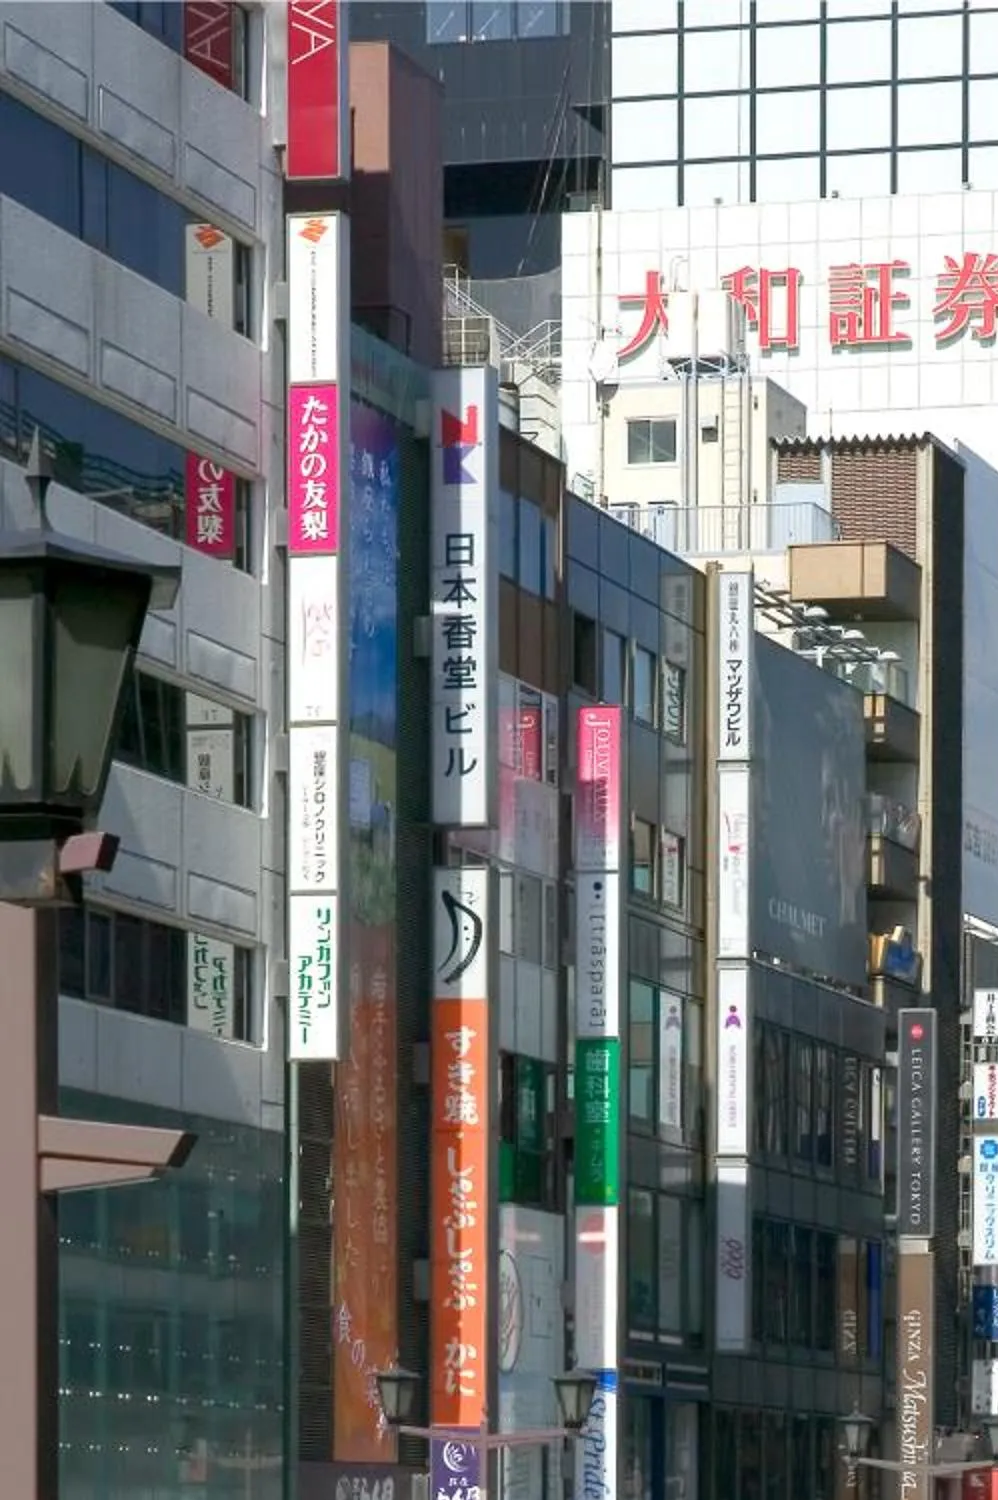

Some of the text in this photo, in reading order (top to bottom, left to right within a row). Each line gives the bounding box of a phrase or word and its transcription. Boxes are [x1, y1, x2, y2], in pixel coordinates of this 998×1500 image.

[300, 395, 329, 541] たかの友梨
[441, 533, 478, 778] 日本香堂ビル
[911, 1048, 922, 1226] LEICA GALLERY TOKYO
[903, 1309, 922, 1361] GINZA
